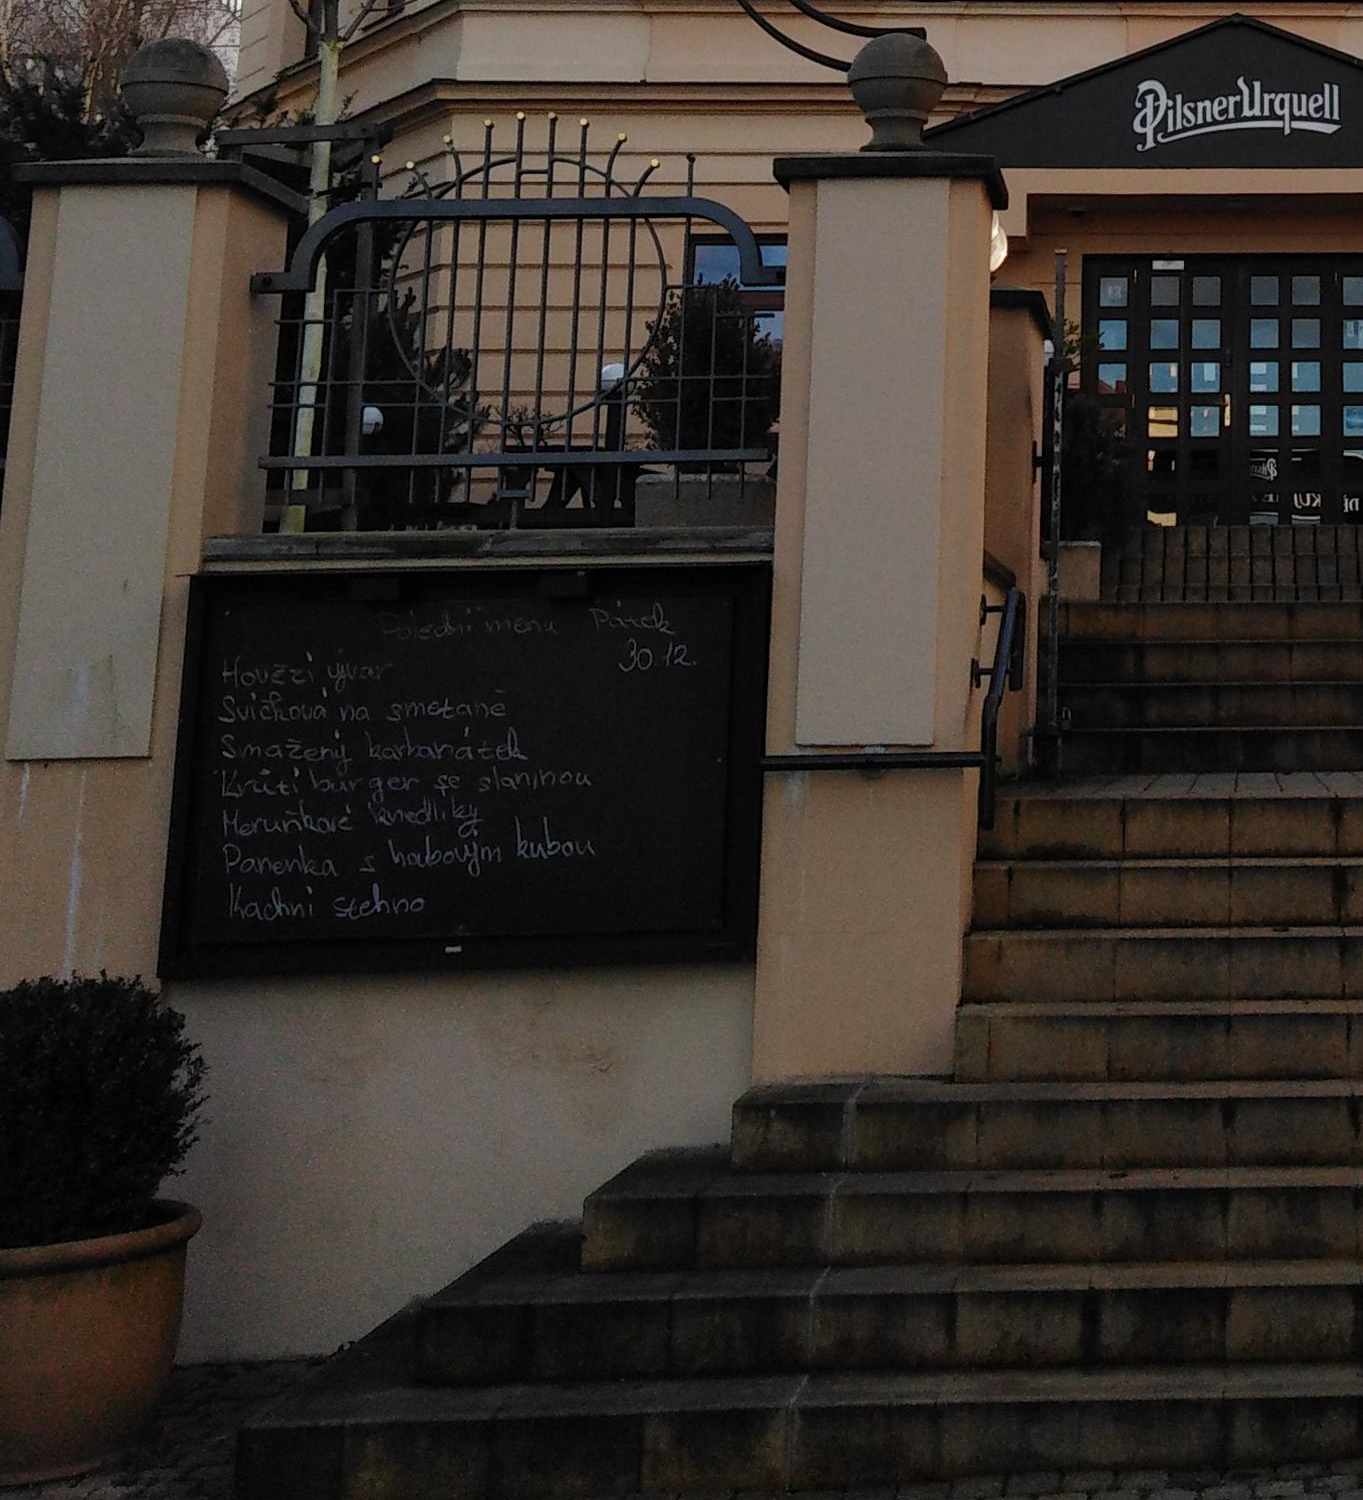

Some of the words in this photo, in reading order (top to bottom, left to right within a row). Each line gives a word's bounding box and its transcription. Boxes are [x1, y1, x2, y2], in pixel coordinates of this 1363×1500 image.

[1132, 79, 1241, 151] Pilsner
[1236, 76, 1341, 135] Urquell
[338, 703, 370, 722] na
[222, 842, 339, 878] Panenka
[359, 854, 376, 873] s
